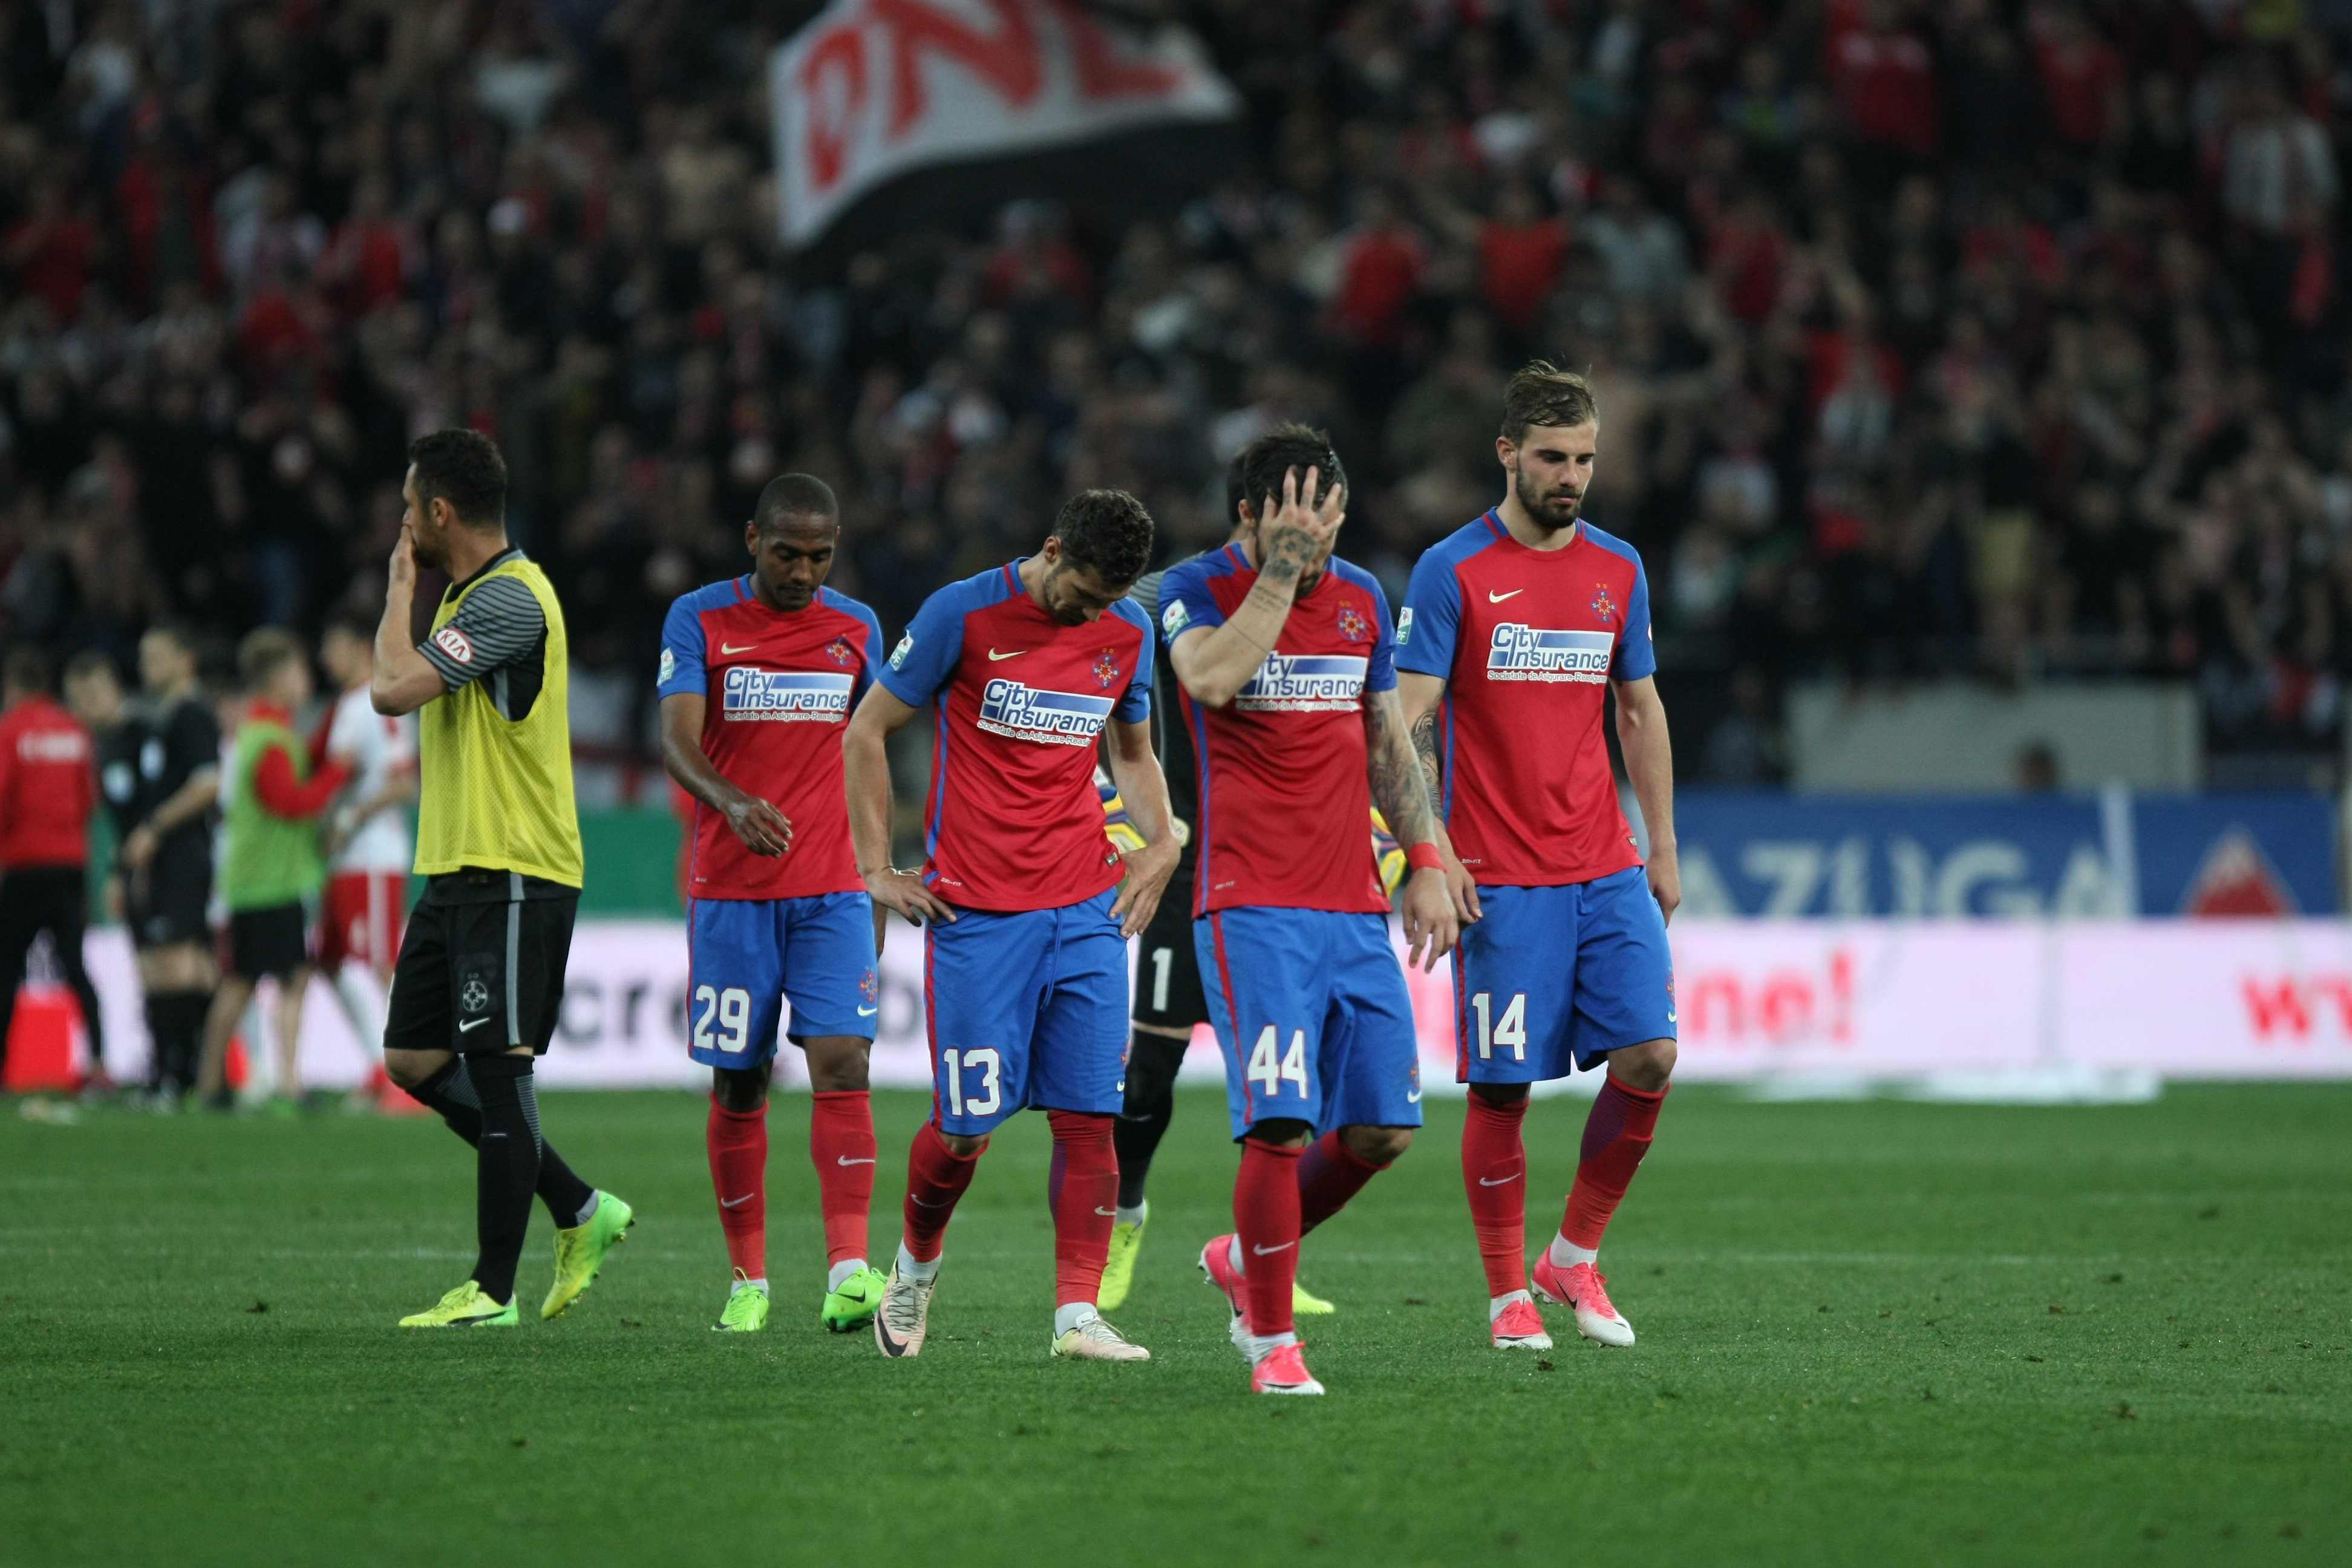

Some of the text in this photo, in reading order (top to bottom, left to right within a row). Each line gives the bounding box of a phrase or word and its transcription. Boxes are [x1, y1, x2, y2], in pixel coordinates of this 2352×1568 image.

[440, 631, 465, 658] KIA
[1494, 625, 1541, 654] City
[1508, 650, 1609, 670] Insurance
[725, 668, 774, 695] City
[1256, 678, 1364, 697] Insurance
[1488, 671, 1526, 681] Societate
[1527, 671, 1537, 681] de
[740, 691, 849, 710] Insurance
[985, 681, 1037, 712] City
[725, 712, 759, 720] Societate
[978, 720, 1015, 737] Societate
[1017, 730, 1028, 739] de
[998, 706, 1105, 734] Insurance
[1152, 947, 1172, 1011] 1
[693, 984, 751, 1053] 29
[1472, 993, 1526, 1060] 14
[1247, 1024, 1307, 1100] 44
[944, 1048, 1001, 1116] 13
